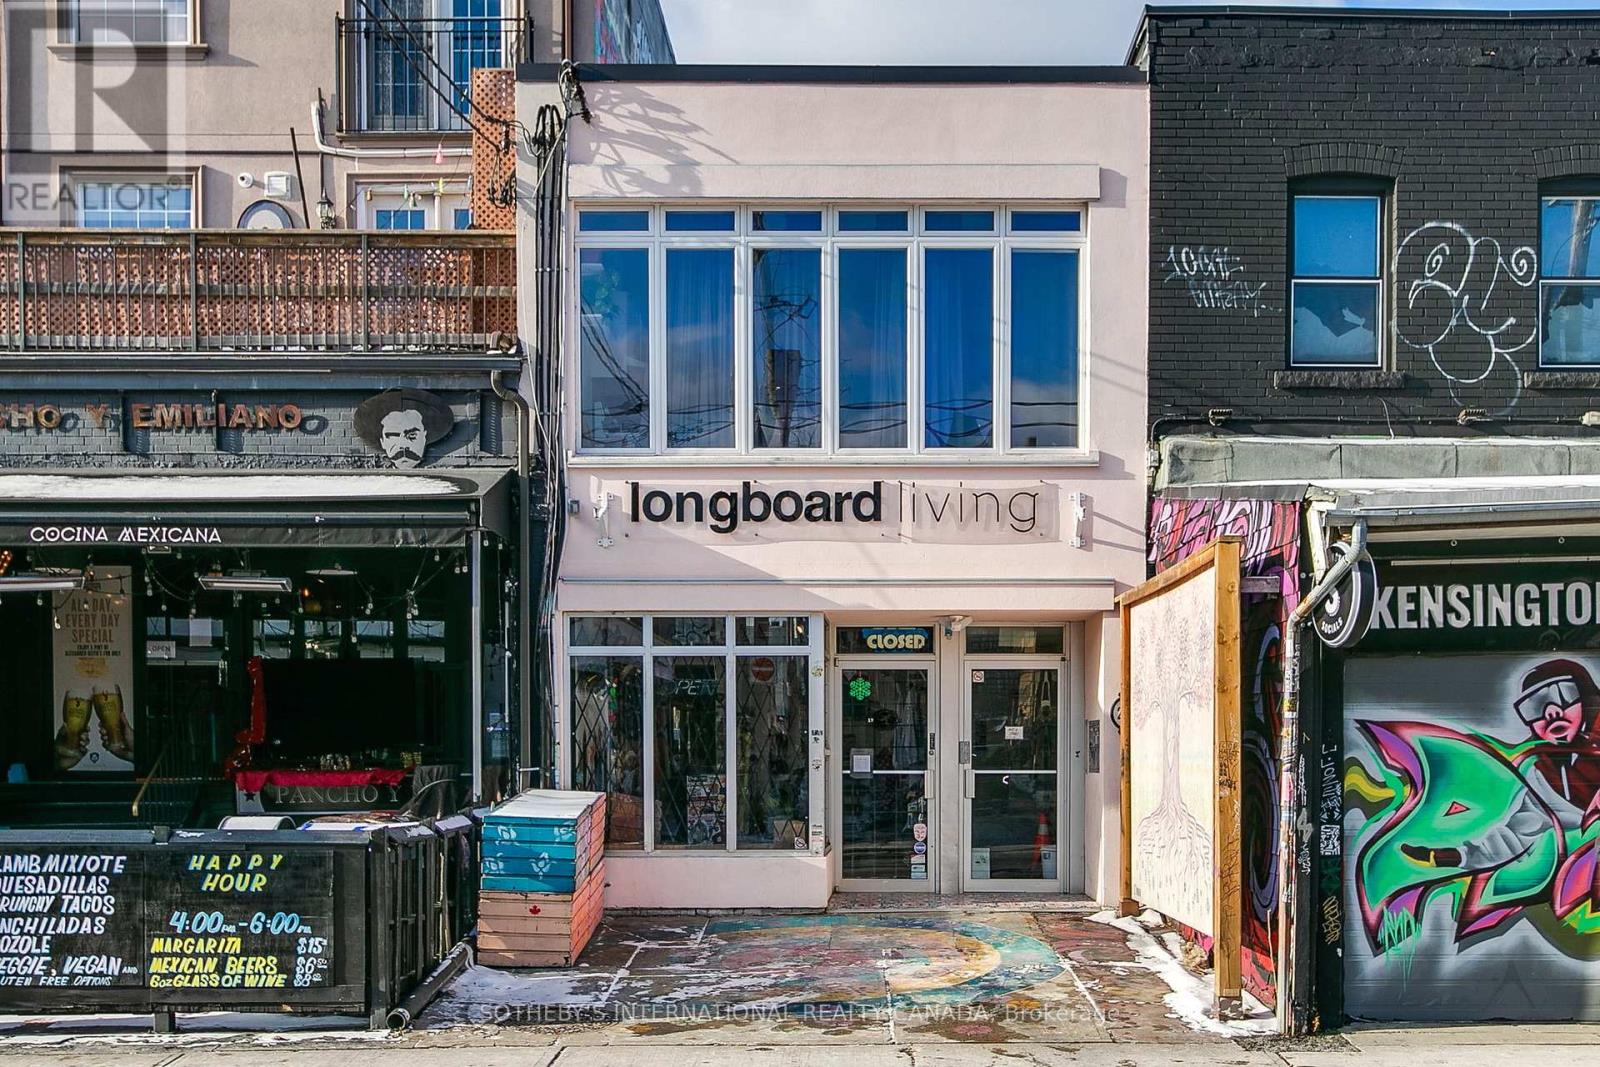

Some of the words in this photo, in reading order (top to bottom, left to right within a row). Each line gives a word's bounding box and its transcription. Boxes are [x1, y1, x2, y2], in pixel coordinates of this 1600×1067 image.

[0, 404, 61, 428] HO
[86, 404, 109, 428] Y
[131, 403, 301, 428] EMILIANO
[630, 481, 883, 534] longboard
[899, 481, 1039, 533] living
[30, 526, 109, 542] COCINA
[117, 526, 222, 543] MEXICANA
[1370, 582, 1600, 629] KENSINGTO
[65, 613, 97, 628] EVERY
[100, 613, 120, 628] DAY
[71, 629, 115, 643] SPECIAL
[866, 634, 926, 649] CLOSED
[275, 786, 379, 803] PANCHO
[388, 781, 401, 802] Y
[0, 854, 41, 874] AMB
[42, 854, 127, 874] MIXIOTE
[188, 854, 284, 870] HAPPY
[0, 876, 110, 894] UESADILLAS
[201, 873, 267, 892] HOUR
[61, 895, 115, 915] TACOS
[150, 937, 242, 954] MARGARITA
[62, 954, 122, 976] VEGAN
[121, 966, 138, 974] AND
[149, 957, 218, 974] MEXICAN
[225, 956, 278, 974] BEERS
[39, 976, 69, 986] FREE
[73, 976, 113, 986] OPTIONS
[173, 975, 220, 988] GLASS
[221, 975, 243, 987] OF
[244, 974, 288, 988] WINE
